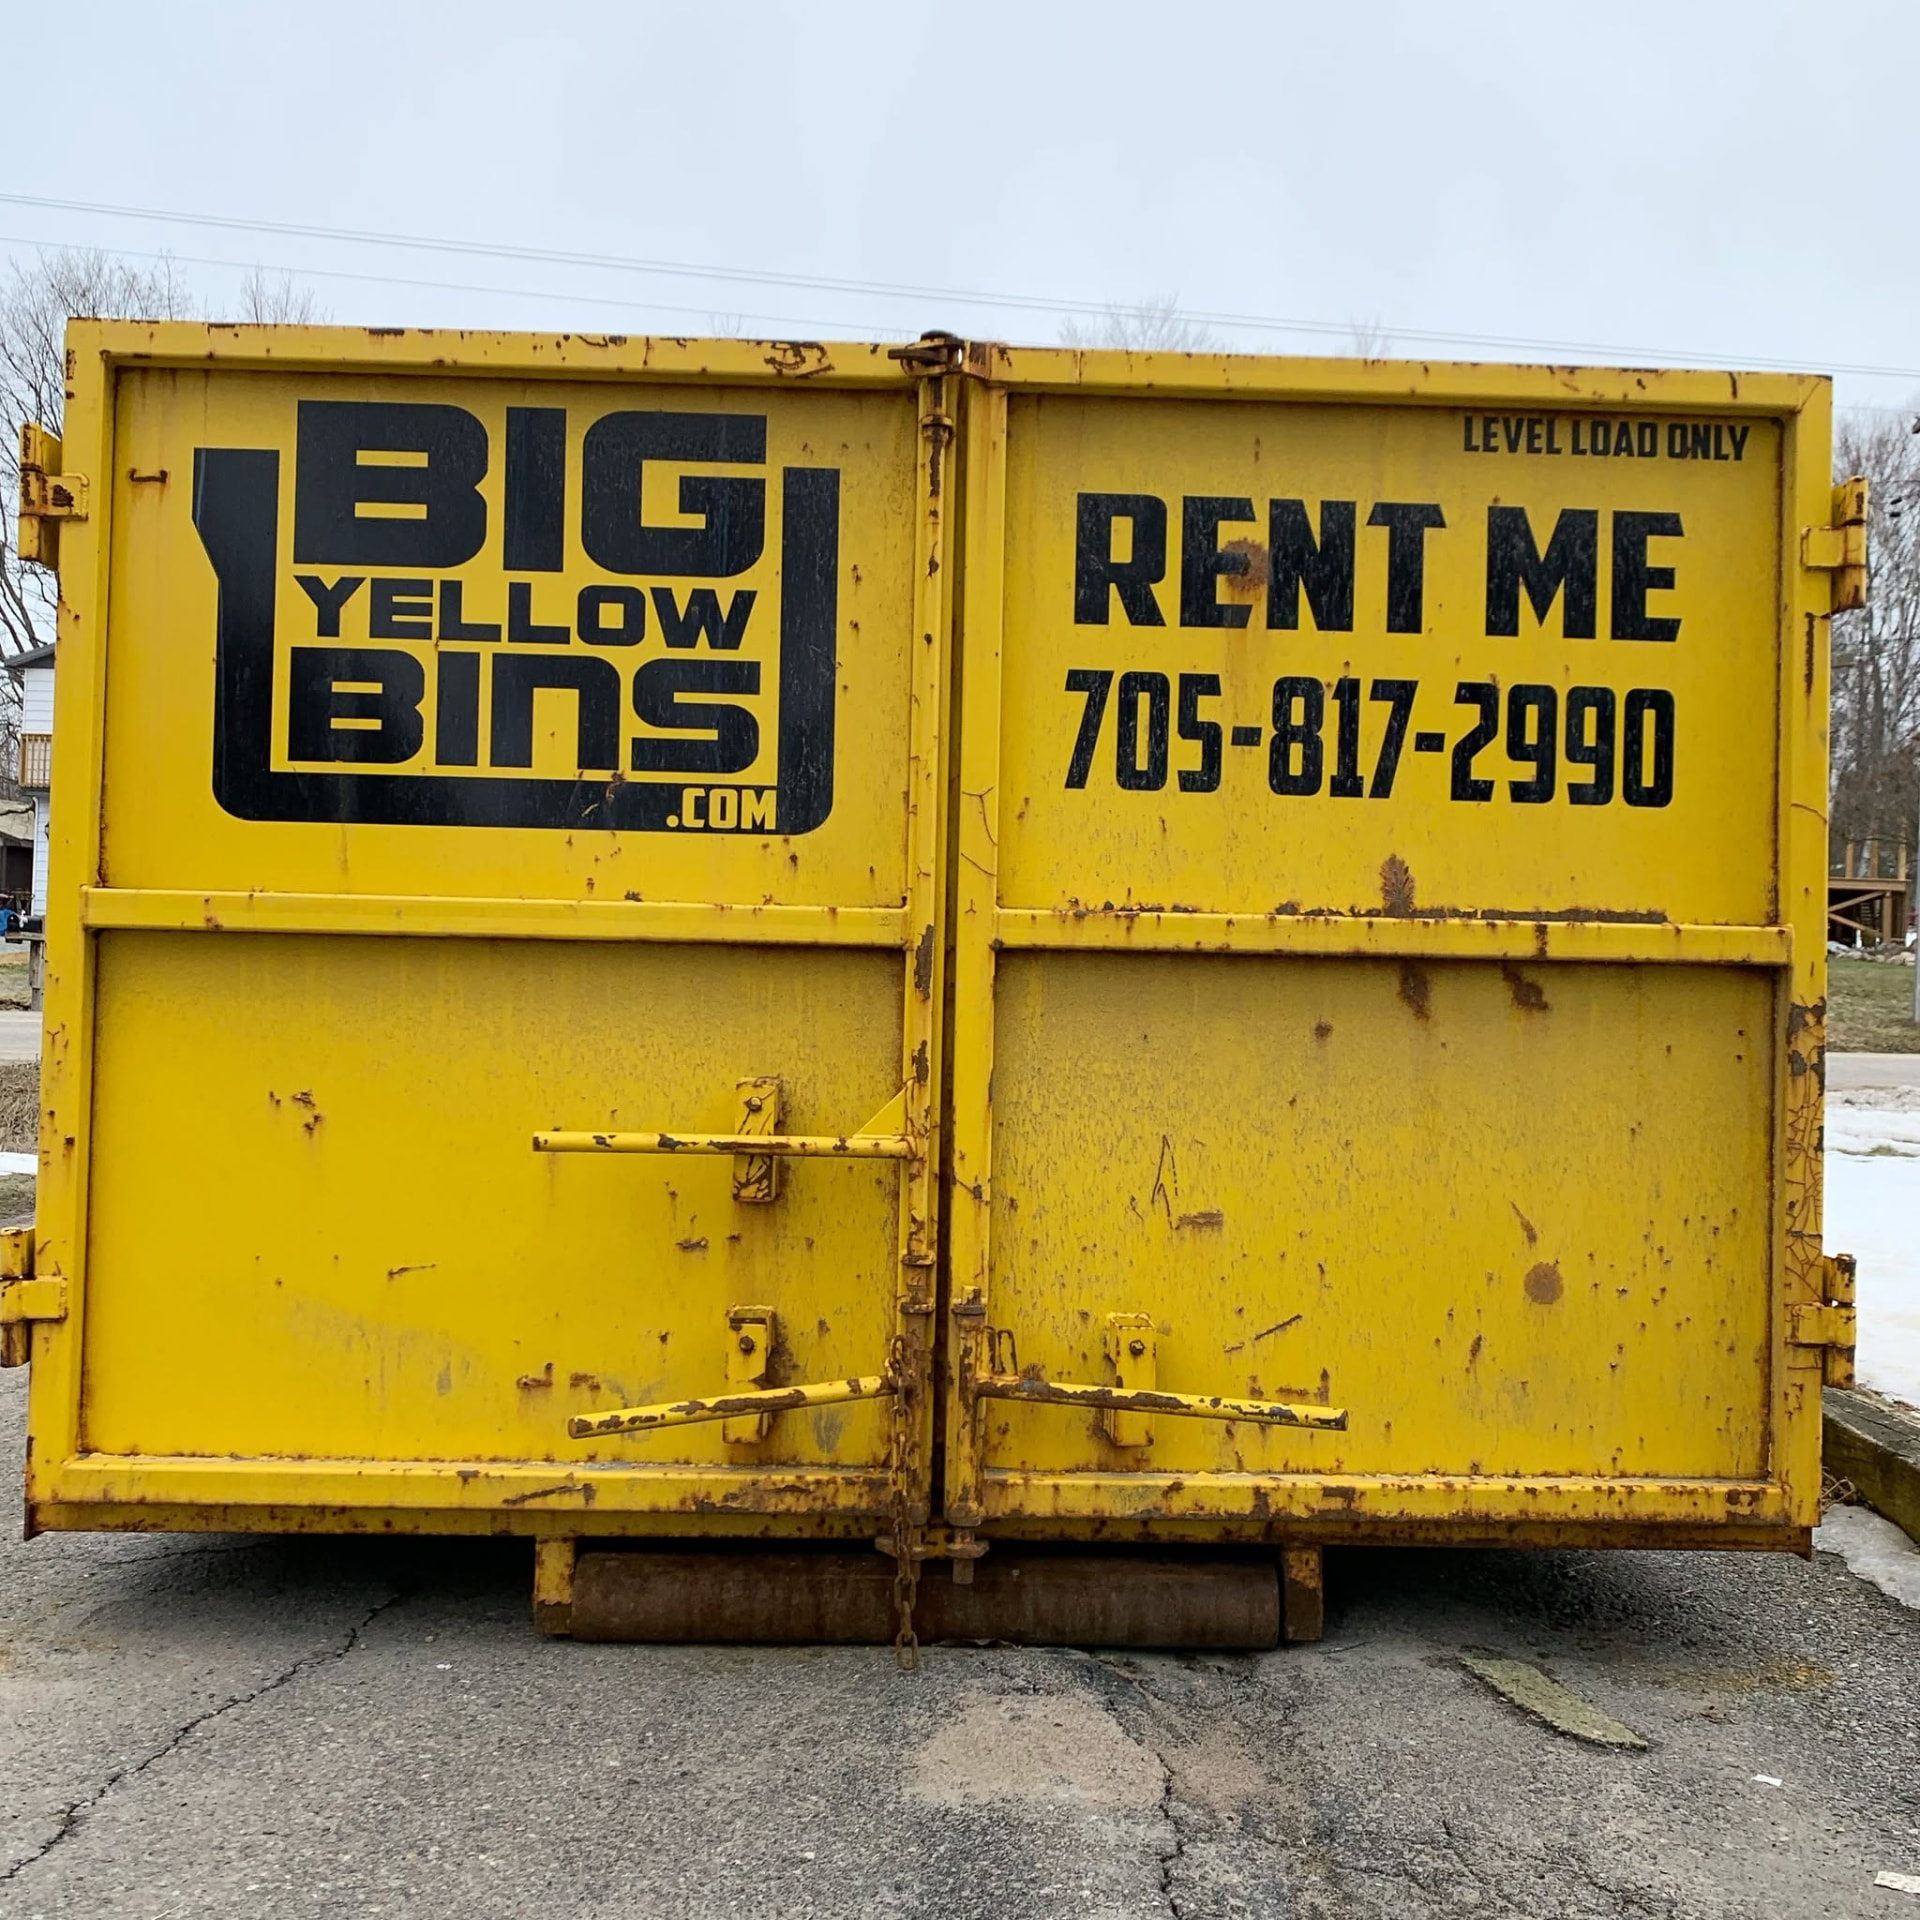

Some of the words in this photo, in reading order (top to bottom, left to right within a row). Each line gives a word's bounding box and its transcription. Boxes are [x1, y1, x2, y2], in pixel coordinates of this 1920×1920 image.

[294, 400, 767, 577] BIG
[1463, 415, 1562, 455] LEVEL
[1571, 419, 1658, 458] LOAD
[1667, 422, 1750, 461] ONLY
[294, 576, 757, 650] YELLOW
[1074, 493, 1446, 634] RENT
[1486, 506, 1685, 642] ME
[1064, 669, 1675, 808] 705-817-2990
[665, 787, 778, 830] .COM
